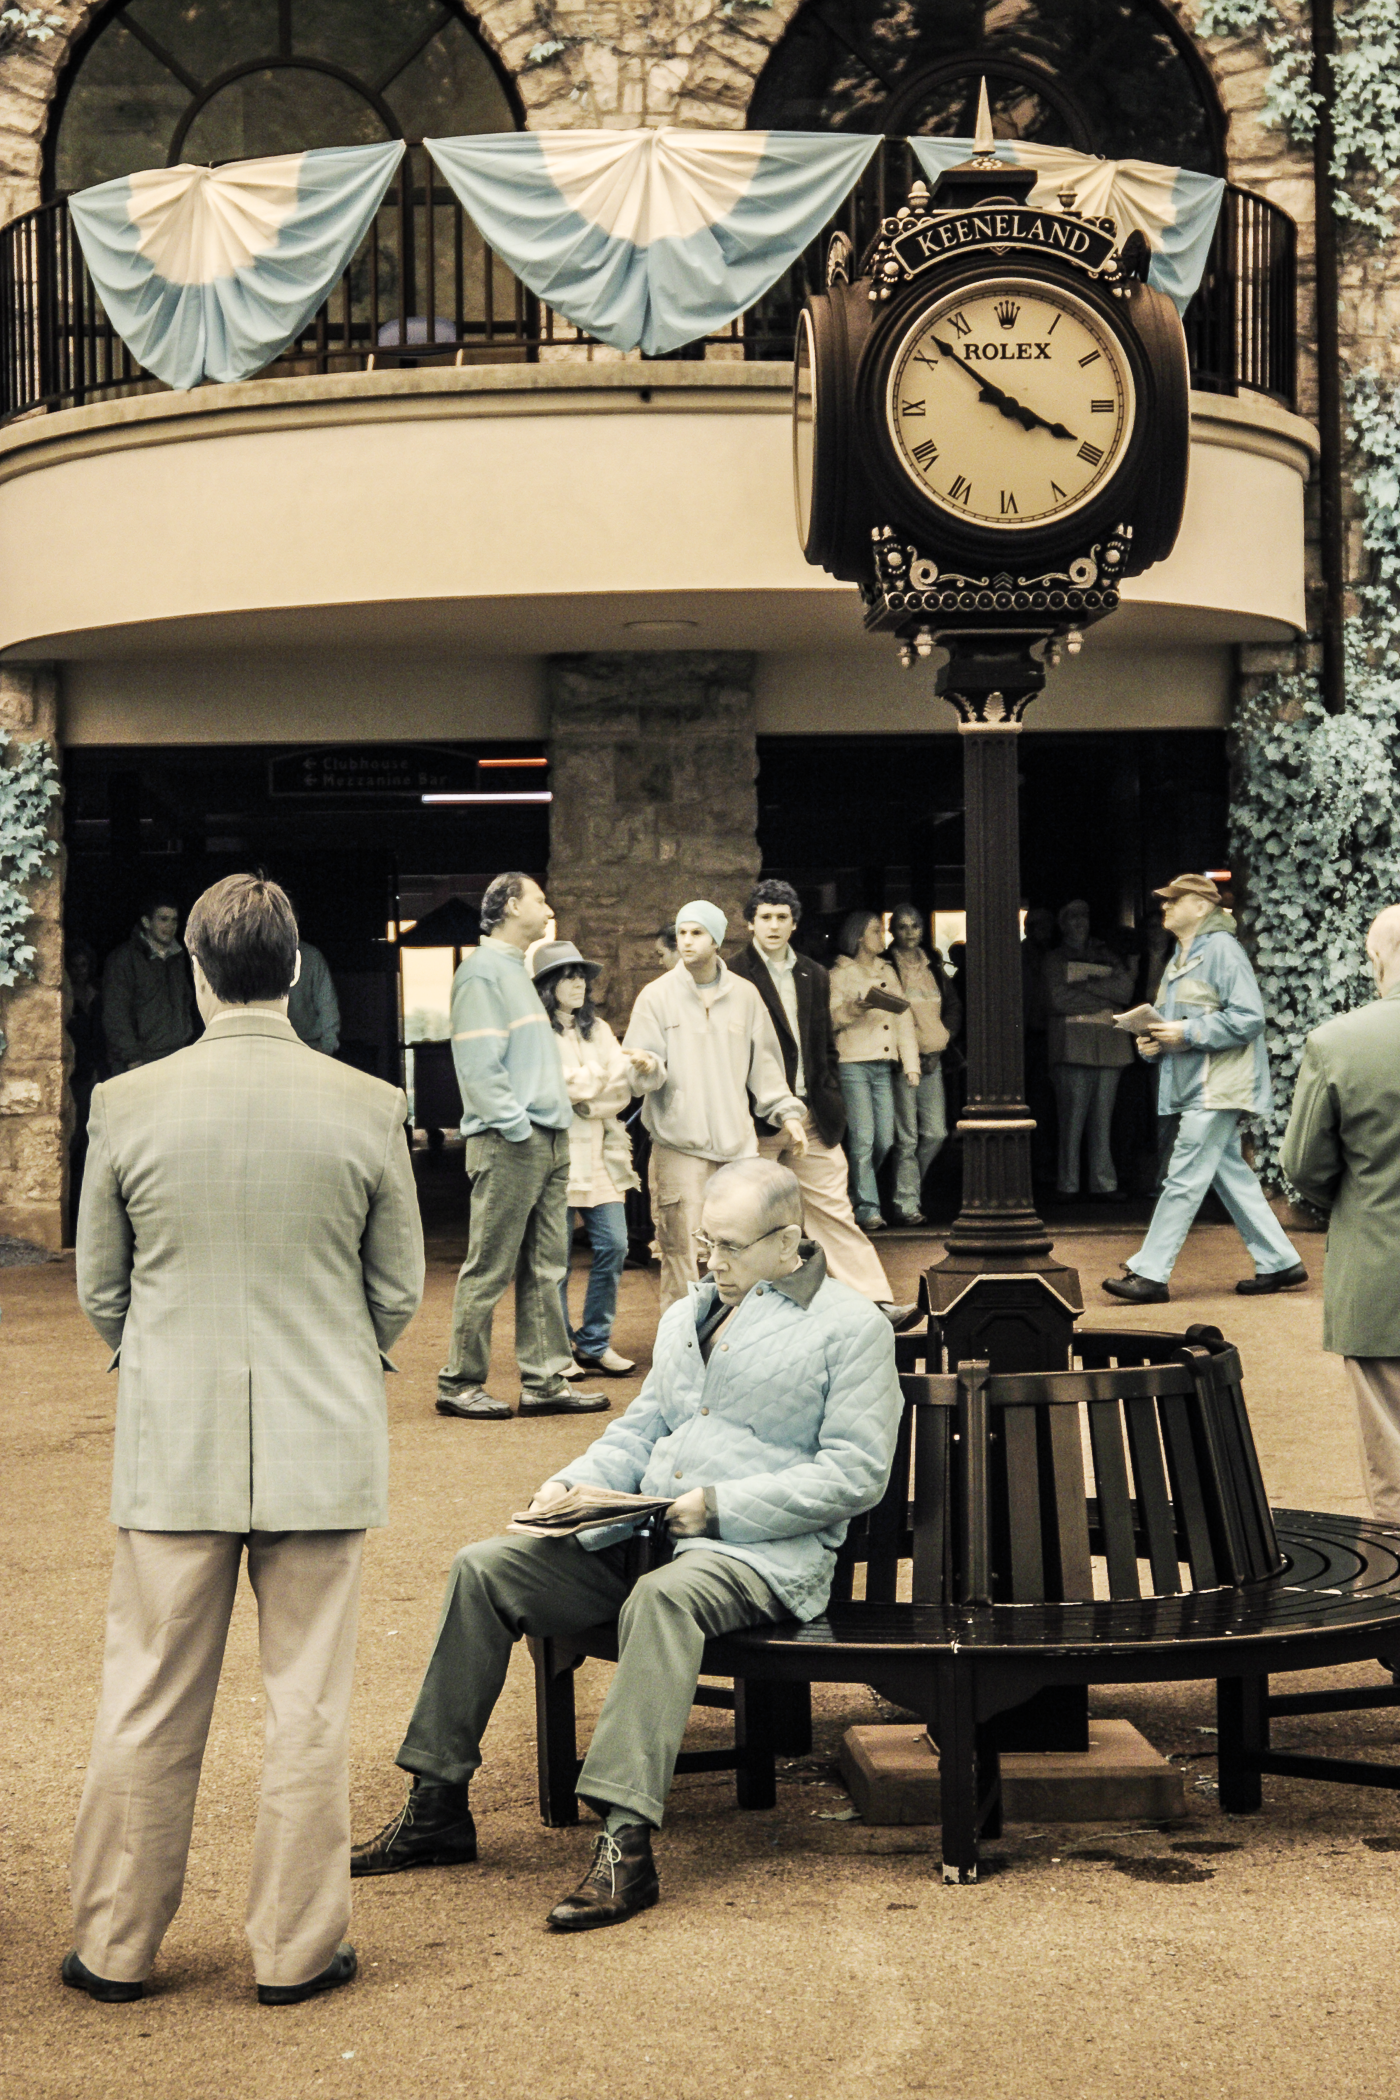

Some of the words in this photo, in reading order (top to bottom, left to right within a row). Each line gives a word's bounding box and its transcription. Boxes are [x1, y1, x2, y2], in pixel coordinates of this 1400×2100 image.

[916, 214, 1091, 257] KEENELAND
[963, 342, 1052, 361] ROLEX
[322, 756, 409, 771] Clubhouse
[322, 773, 411, 787] Mezzanine
[418, 771, 448, 786] Bar
